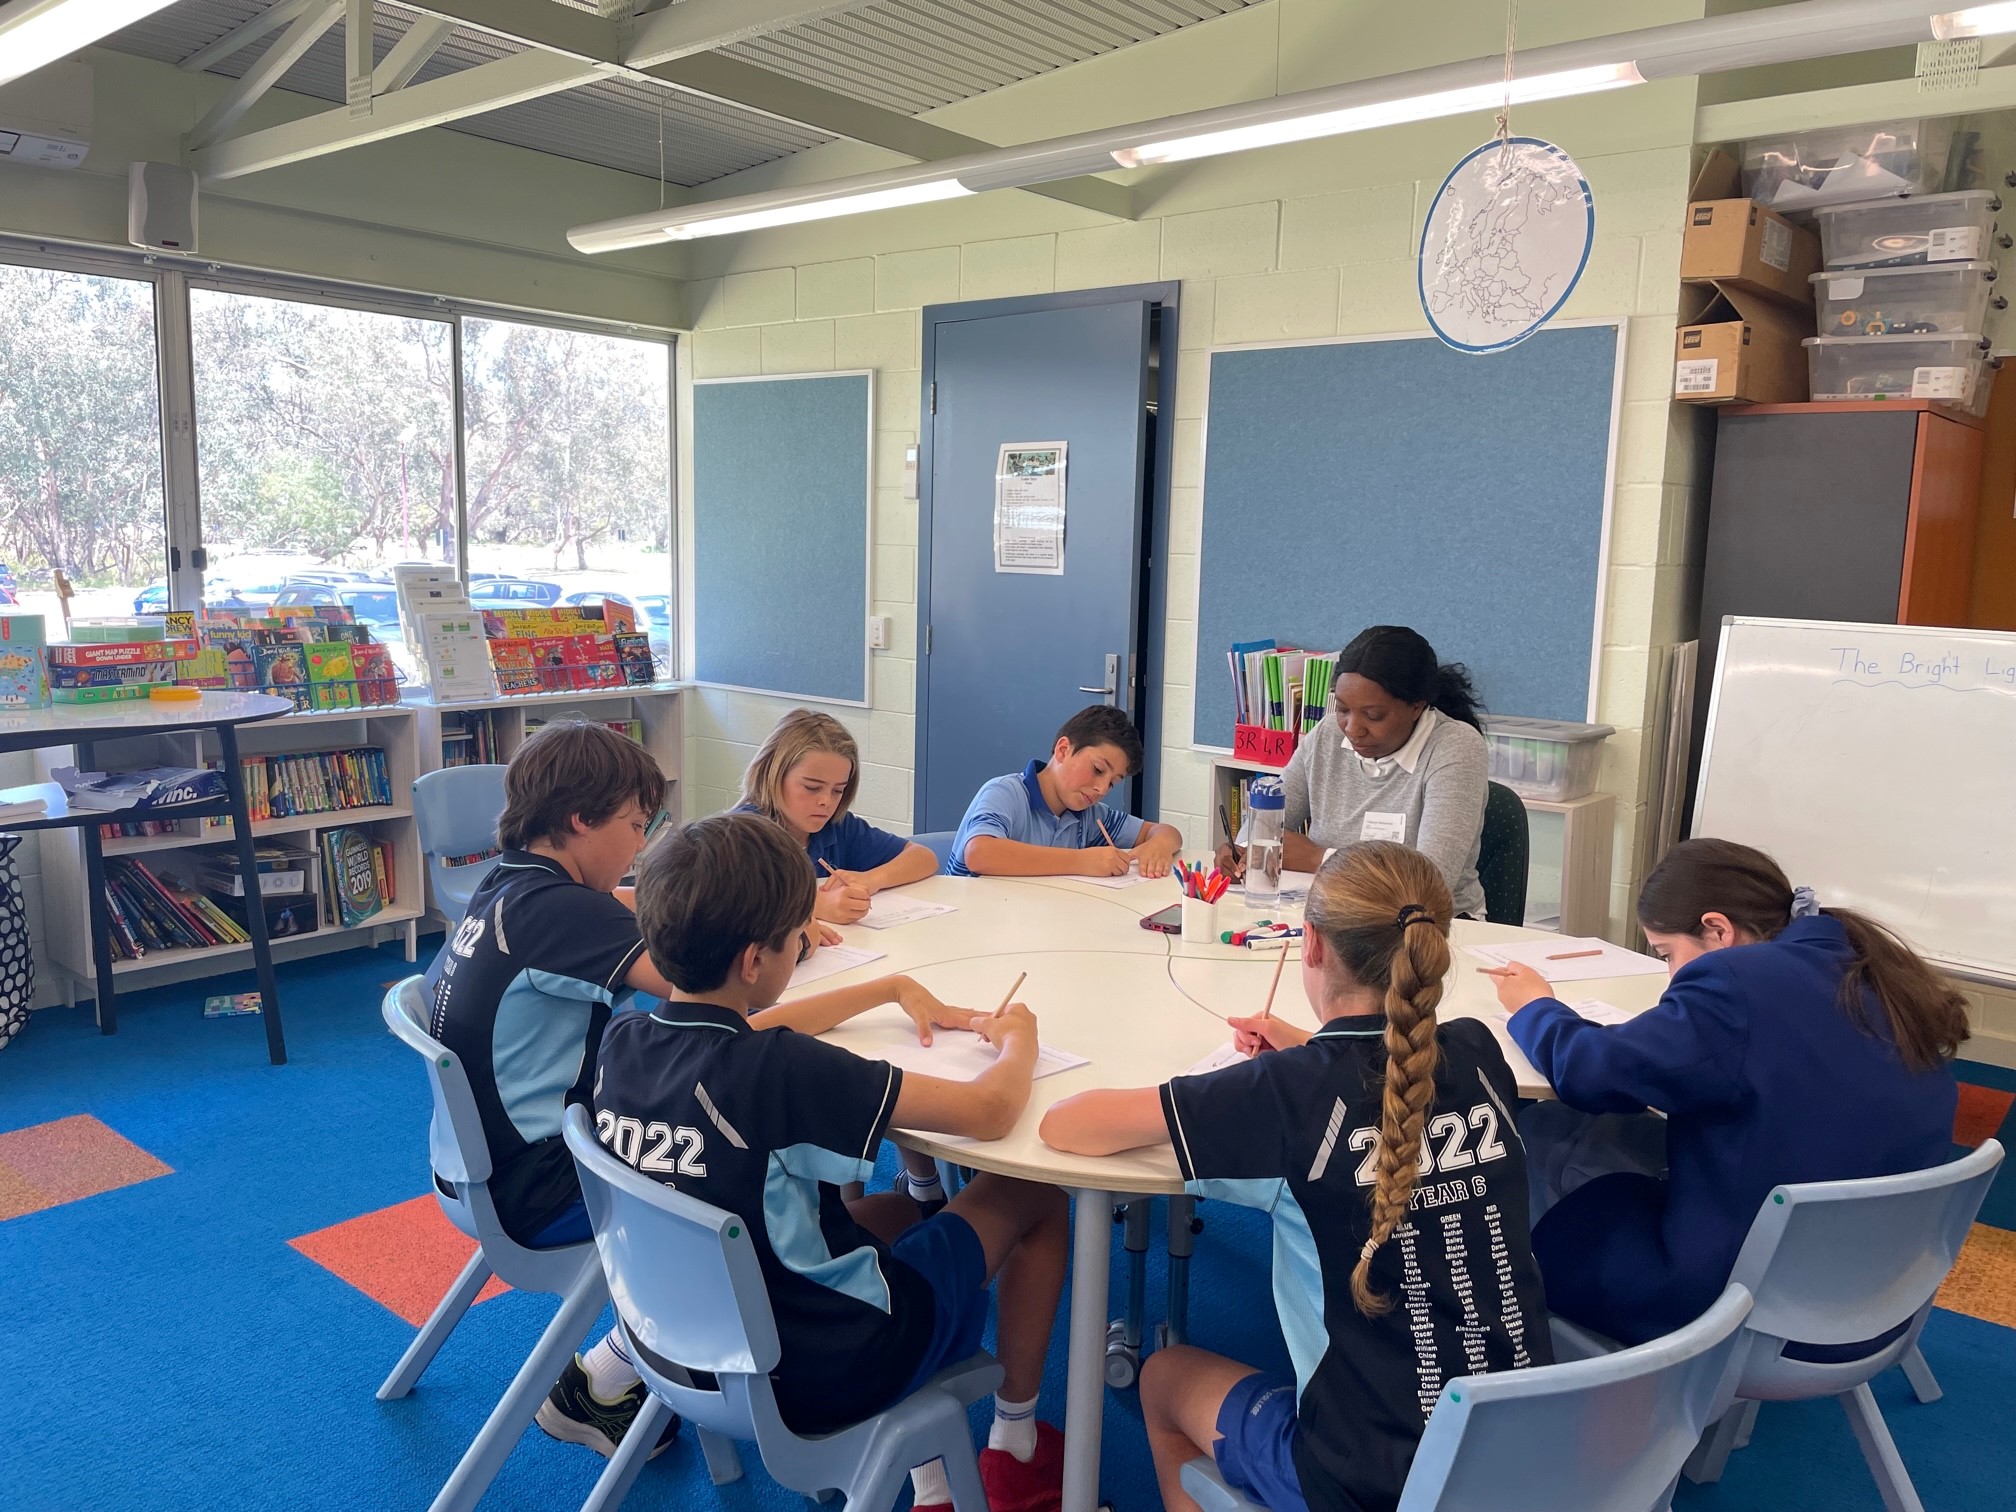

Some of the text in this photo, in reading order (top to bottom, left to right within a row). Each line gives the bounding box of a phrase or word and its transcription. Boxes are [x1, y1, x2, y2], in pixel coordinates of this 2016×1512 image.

[1695, 212, 1711, 220] LEGO
[1684, 334, 1700, 344] LEGO
[210, 630, 235, 640] funny
[86, 649, 105, 658] GIANT
[1830, 648, 1882, 675] The
[1898, 650, 1960, 683] Bright
[1236, 730, 1285, 756] 3R 4R
[346, 842, 367, 856] GUINNESS
[347, 851, 369, 867] WORLD
[348, 861, 370, 876] RECORDS
[351, 870, 372, 895] 2019
[596, 1109, 707, 1177] 2022
[1410, 1176, 1487, 1211] YEAR 6
[1486, 1204, 1497, 1213] RED
[1440, 1213, 1461, 1223] GREEN
[1392, 1229, 1420, 1239] Annabelle
[1445, 1251, 1468, 1260] Mitchell
[1404, 1268, 1421, 1276] Tayla
[1453, 1281, 1473, 1290] Scarlett
[1410, 1322, 1434, 1331] Isabelle
[1468, 1361, 1488, 1370] Samuel
